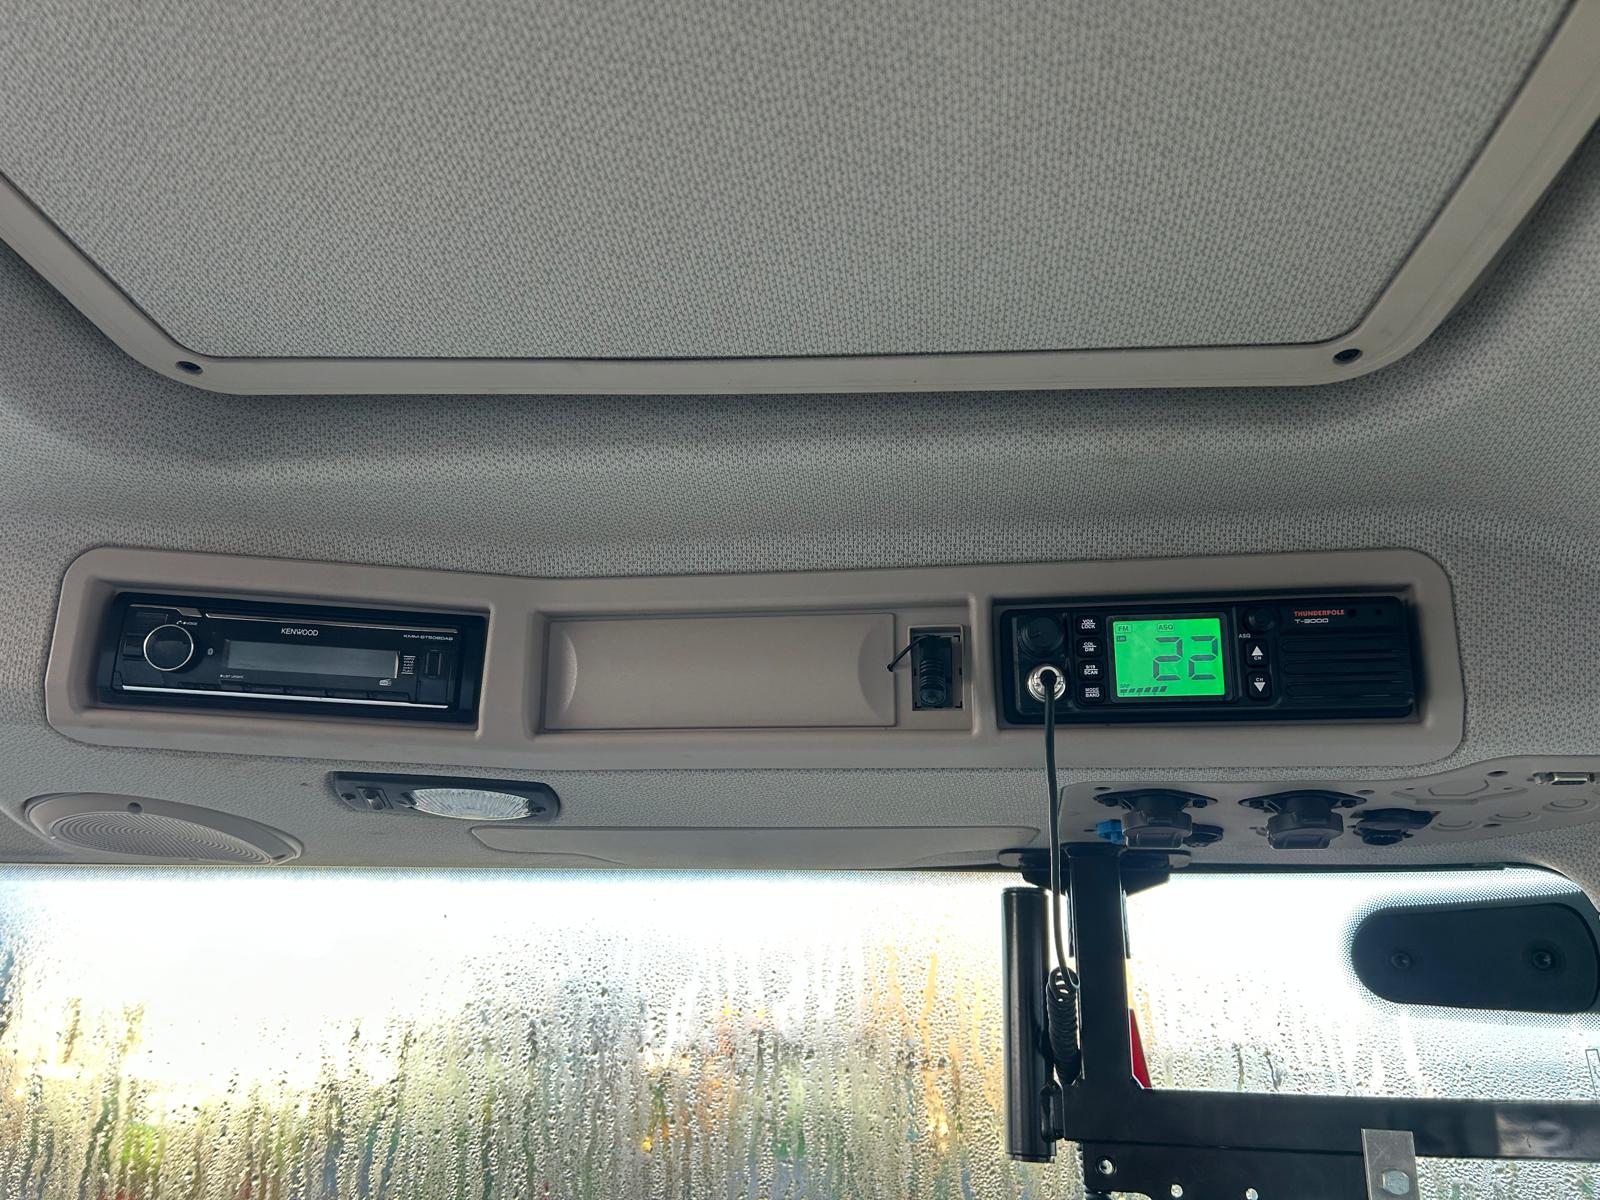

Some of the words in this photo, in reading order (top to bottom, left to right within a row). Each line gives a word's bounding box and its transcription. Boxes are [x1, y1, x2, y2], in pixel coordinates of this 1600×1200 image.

[1294, 609, 1345, 617] THUNDERPOLE
[281, 627, 319, 637] KENWOOD
[1153, 636, 1218, 681] 22
